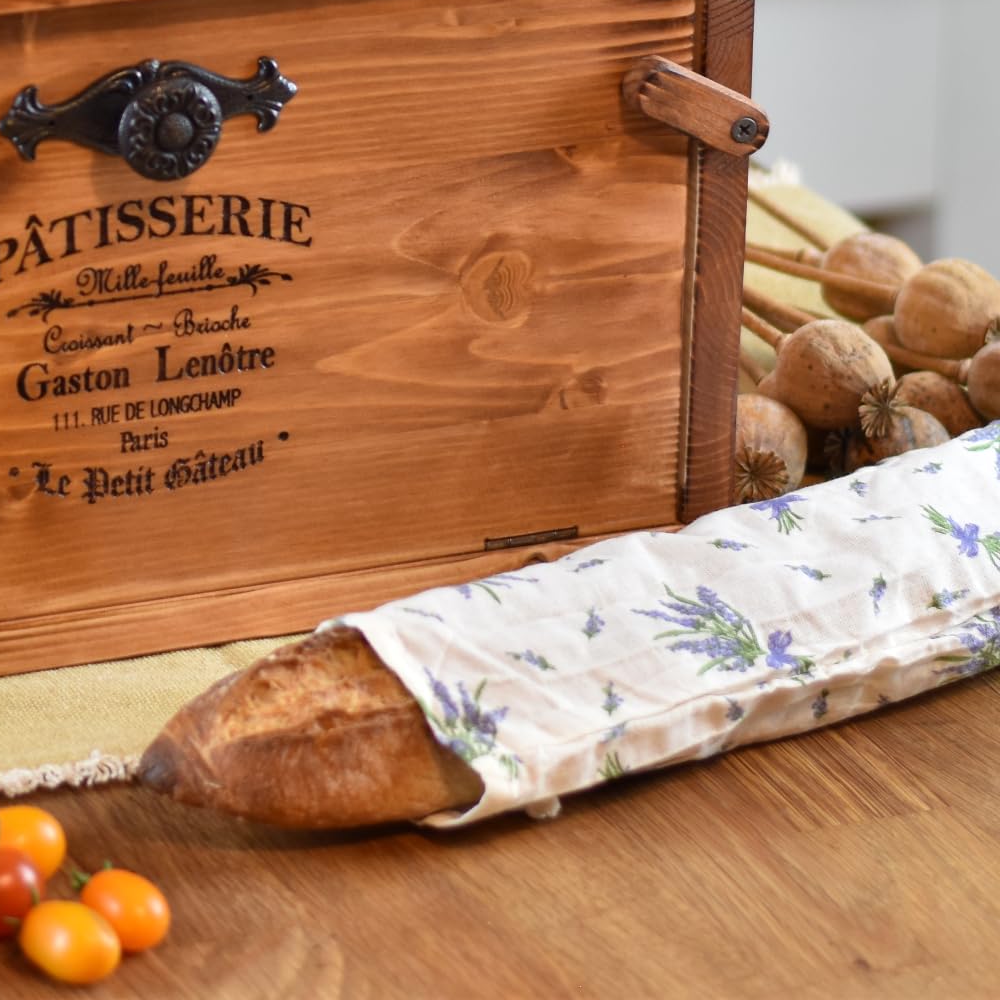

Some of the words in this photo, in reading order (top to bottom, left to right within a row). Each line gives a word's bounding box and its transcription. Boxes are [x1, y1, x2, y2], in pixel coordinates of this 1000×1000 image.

[42, 324, 135, 355] Croissant
[173, 304, 251, 338] Brioche
[16, 361, 131, 402] Gaston
[154, 342, 276, 383] Lenôtre
[91, 403, 121, 427] RUE
[125, 400, 145, 421] DE
[150, 387, 242, 418] LONGCHAMP
[119, 426, 170, 454] Paris
[31, 461, 72, 499] Le
[81, 464, 156, 505] Petit
[163, 439, 266, 491] Gâteau
